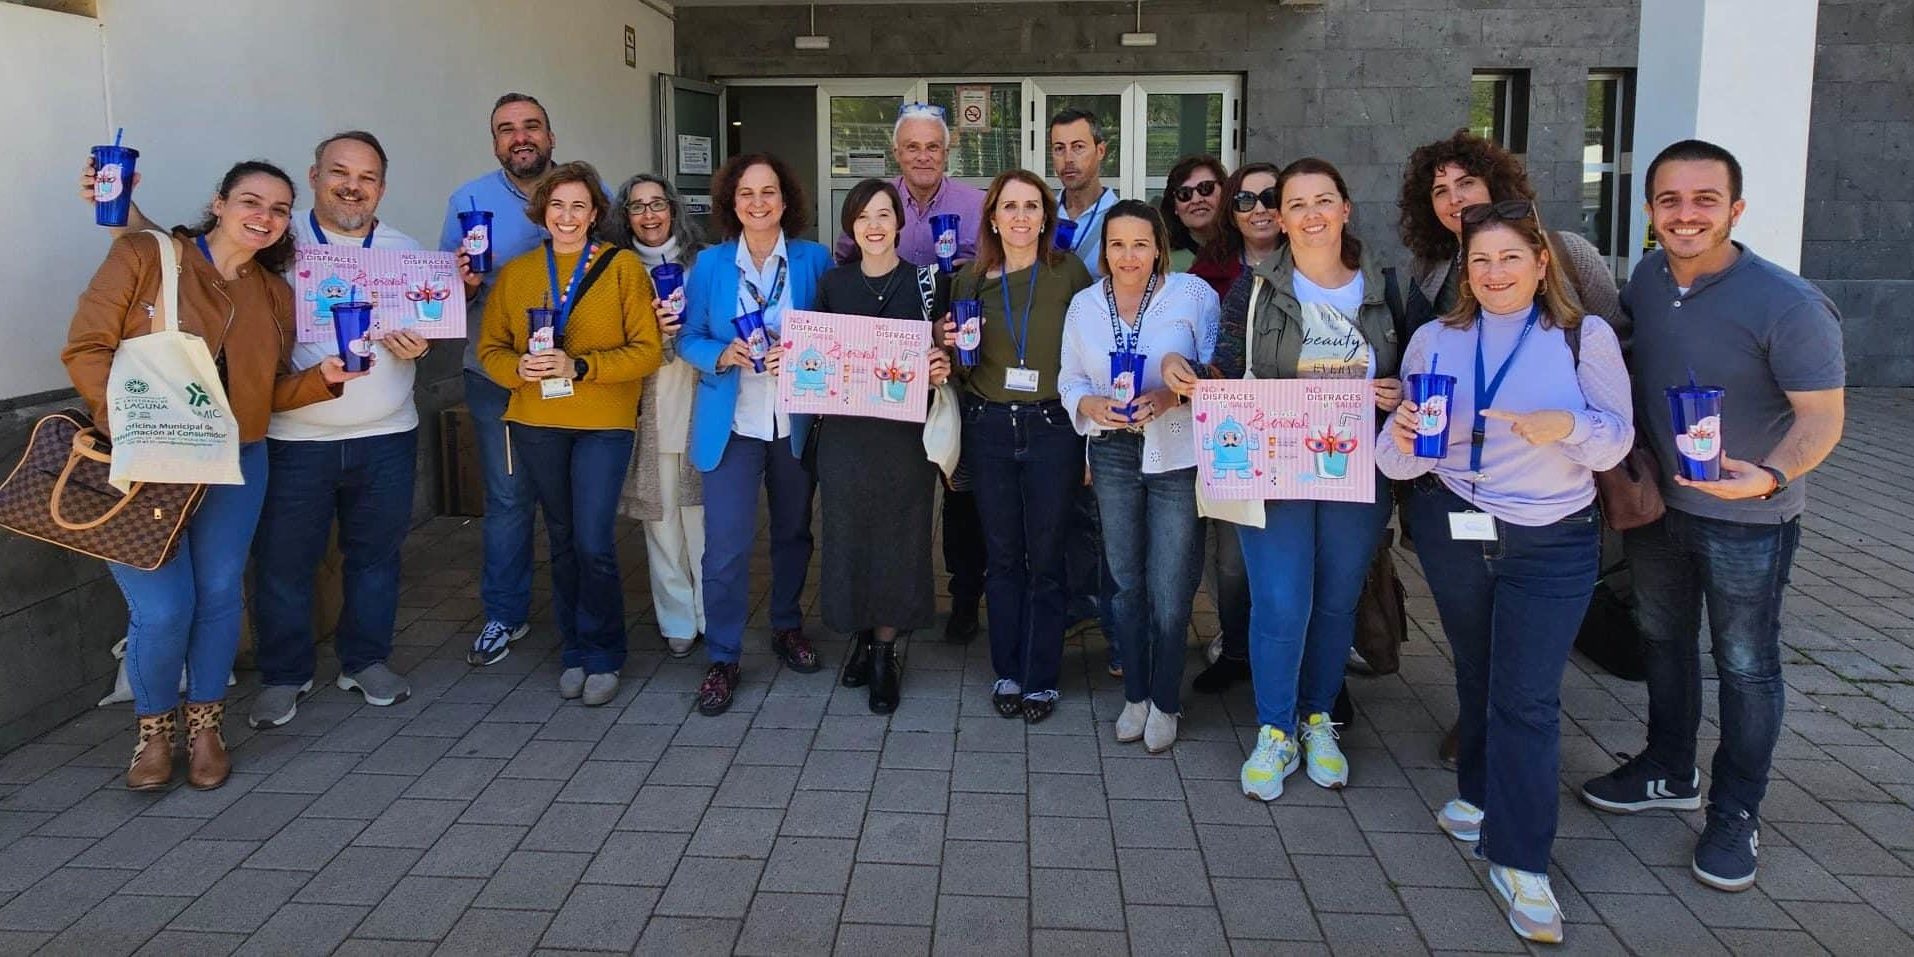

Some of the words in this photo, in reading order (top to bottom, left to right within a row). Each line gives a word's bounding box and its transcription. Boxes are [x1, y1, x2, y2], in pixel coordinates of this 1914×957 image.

[306, 254, 358, 264] DISFRACES
[790, 324, 834, 333] DISFRACES
[876, 330, 921, 341] DISFRACES
[1302, 327, 1364, 362] beauty
[1202, 393, 1255, 401] DISFRACES
[1307, 393, 1362, 401] DISFRACES
[124, 401, 170, 410] LAGUNA
[1335, 401, 1362, 409] SALUD
[125, 422, 157, 431] Oficina
[159, 423, 203, 431] Municipal
[177, 429, 228, 438] Consumidor
